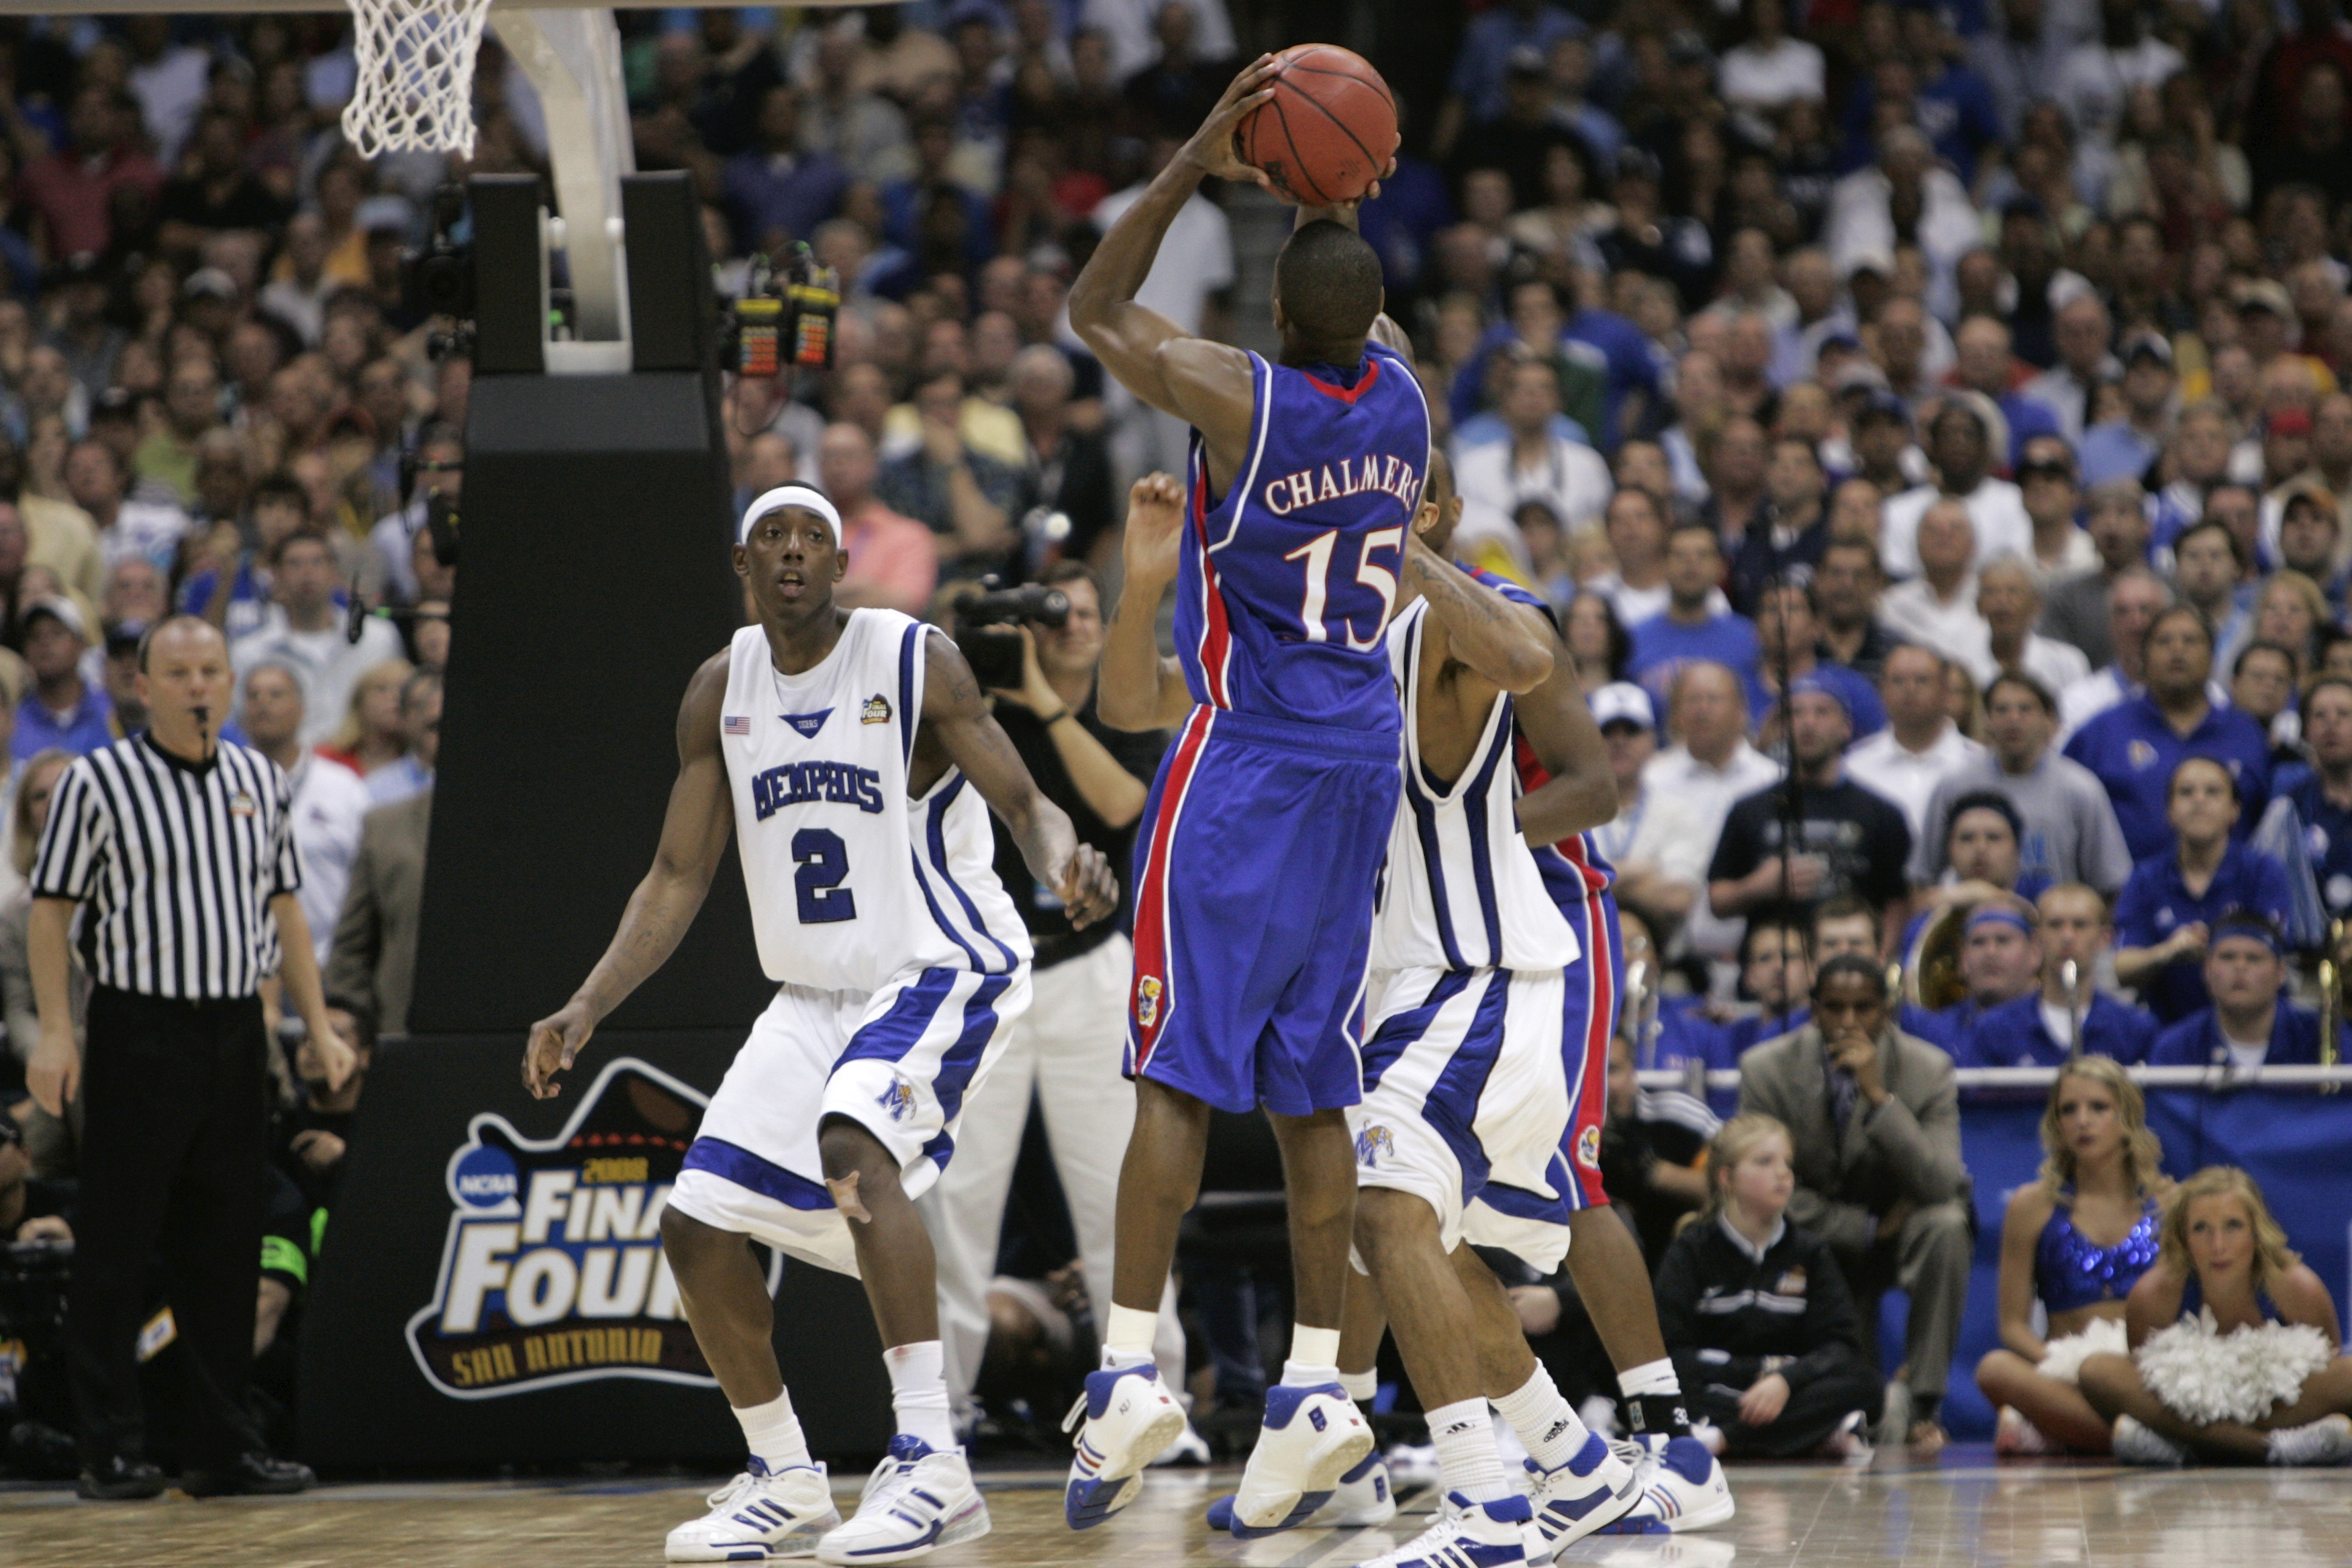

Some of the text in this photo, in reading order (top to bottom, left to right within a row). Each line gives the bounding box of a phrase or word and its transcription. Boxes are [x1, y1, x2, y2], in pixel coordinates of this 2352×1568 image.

[1281, 525, 1403, 652] 15
[863, 708, 887, 718] FOUR
[752, 761, 884, 822] MEMPHIS
[791, 828, 856, 924] 2
[458, 1174, 518, 1195] NCAA
[582, 1157, 648, 1183] 2008
[452, 1328, 663, 1386] SAN ANTONIO
[1544, 1419, 1569, 1442] adidas
